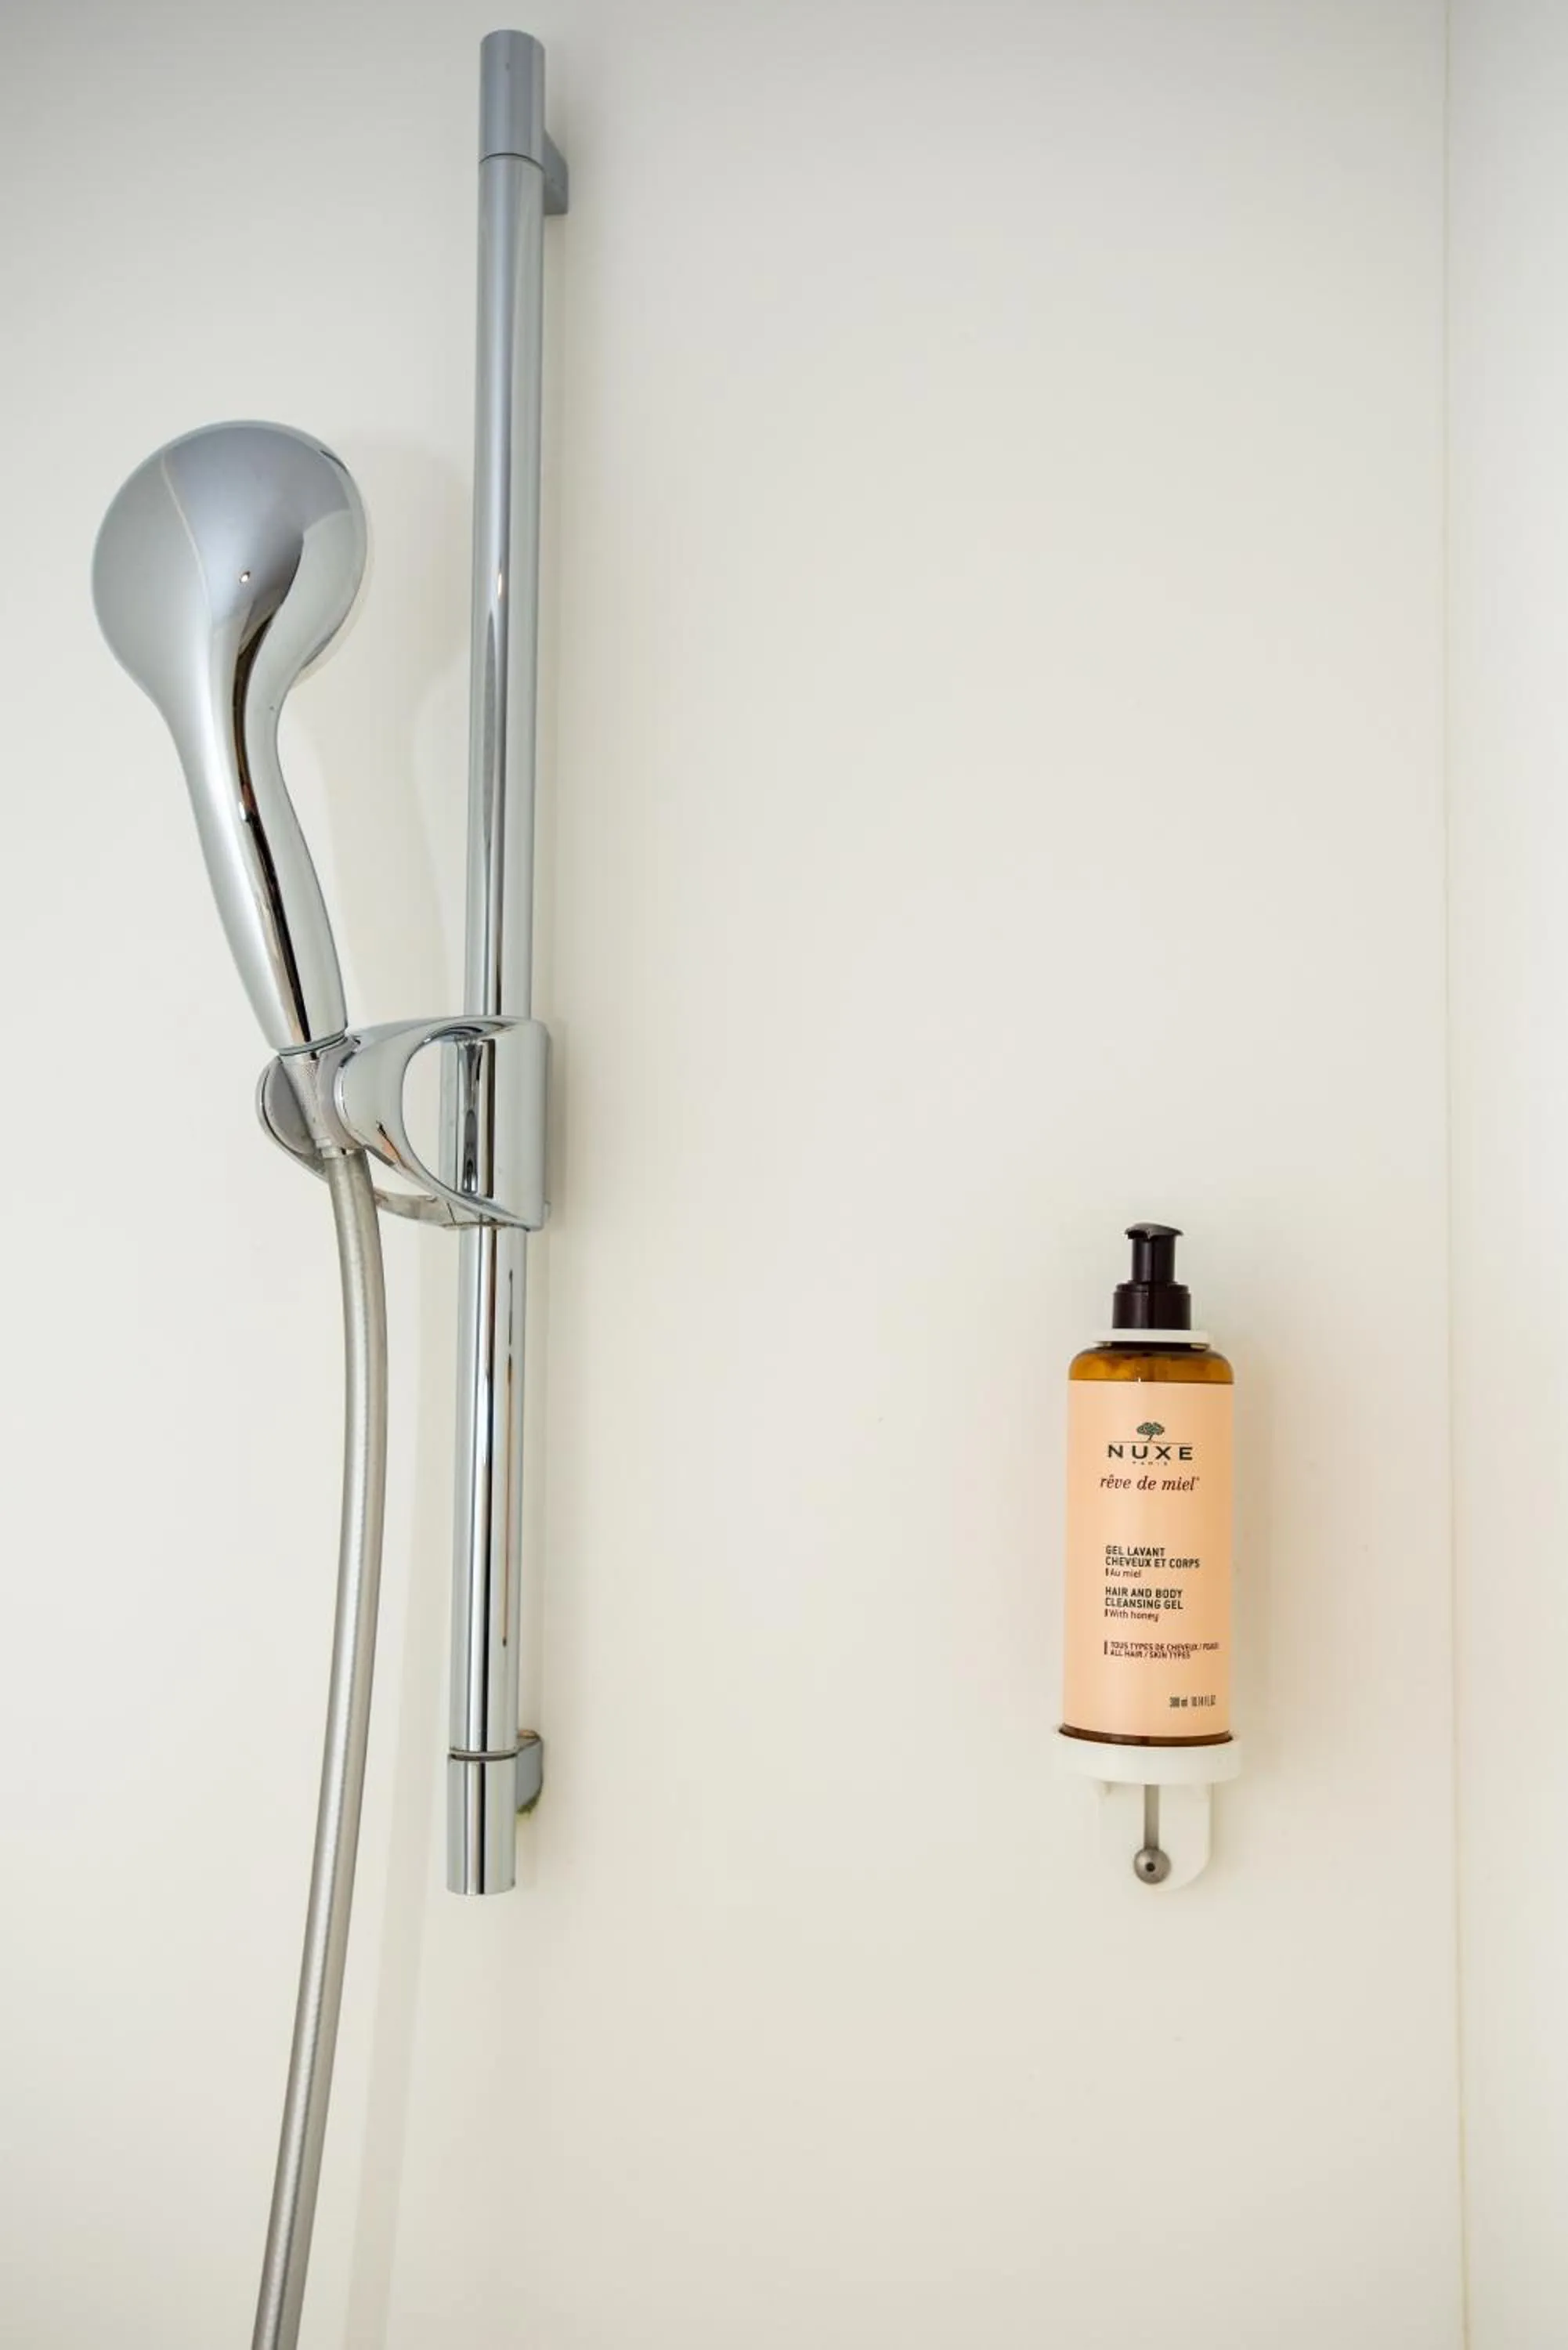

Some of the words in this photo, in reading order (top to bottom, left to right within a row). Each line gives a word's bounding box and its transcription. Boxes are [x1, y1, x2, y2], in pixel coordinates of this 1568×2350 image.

[1107, 1444, 1193, 1460] NUXE
[1100, 1474, 1131, 1488] rêve
[1137, 1476, 1156, 1490] de
[1105, 1546, 1123, 1555] GEL
[1128, 1547, 1165, 1556] LAVANT
[1105, 1557, 1151, 1567] CHEVEUX
[1154, 1559, 1166, 1567] ET
[1169, 1559, 1200, 1568] CORPS
[1105, 1587, 1128, 1596] HAIR
[1131, 1589, 1152, 1598] AND
[1155, 1589, 1183, 1599] BODY
[1105, 1598, 1161, 1609] CLEANSING
[1164, 1600, 1183, 1610] GEL
[1110, 1610, 1129, 1619] With
[1131, 1611, 1159, 1622] honey
